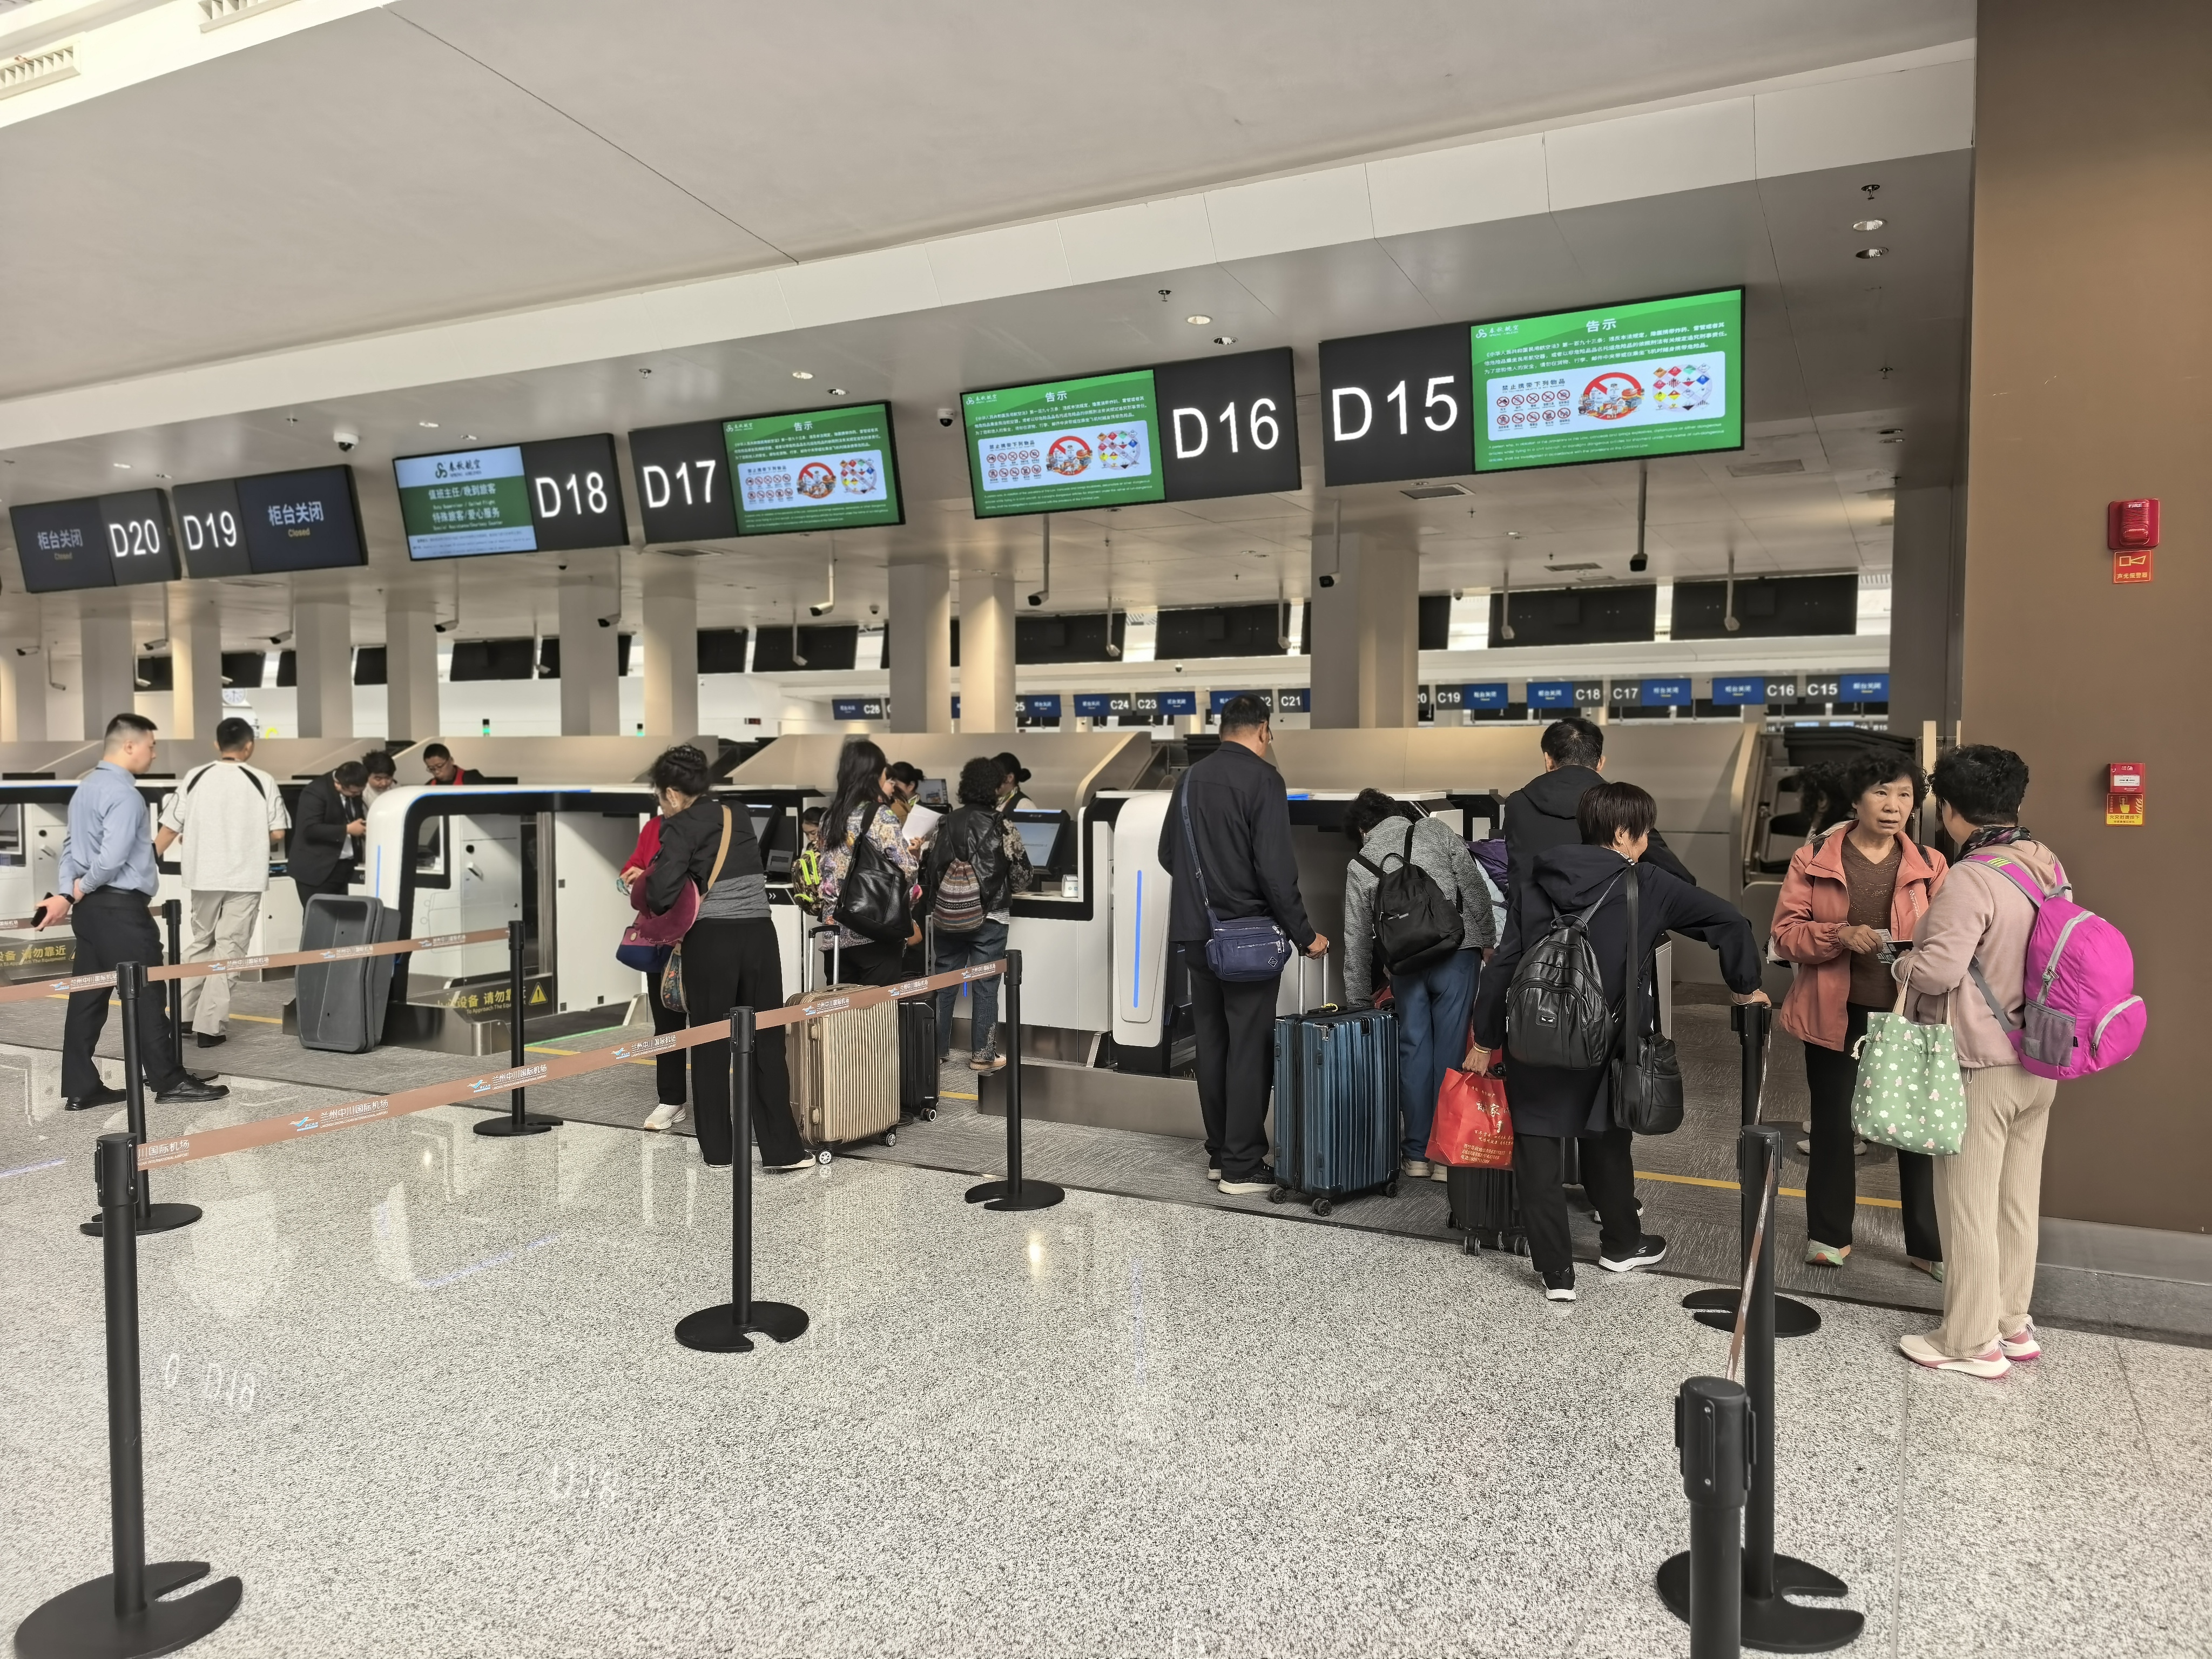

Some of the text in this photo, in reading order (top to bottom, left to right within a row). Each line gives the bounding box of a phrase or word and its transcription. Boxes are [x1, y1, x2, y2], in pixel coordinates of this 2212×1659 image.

[1586, 318, 1616, 333] 告示
[1045, 390, 1067, 402] 告示
[1332, 376, 1457, 441] D15
[794, 421, 813, 431] 告示
[1173, 399, 1278, 458] D16
[643, 460, 716, 508] D17
[536, 472, 607, 517] D18
[268, 501, 324, 526] 柜台关闭
[184, 511, 236, 550] D19
[288, 528, 310, 538] Closed
[37, 529, 83, 550] 柜台关闭
[109, 520, 159, 557] D20
[1576, 689, 1600, 700] C18
[1613, 688, 1638, 700] C17
[1767, 684, 1795, 696] C16
[1807, 684, 1837, 696] C15
[1281, 696, 1300, 706] C21
[1438, 692, 1460, 703] C19
[1015, 703, 1025, 712] 25
[1110, 700, 1129, 710] C24
[1137, 699, 1157, 709] C23
[473, 1004, 494, 1014] Approach
[817, 997, 849, 1009] 兰州中川国际机场
[631, 1035, 676, 1051] 兰州中川国际机场
[492, 1064, 547, 1083] 兰州中川国际机场
[321, 1099, 388, 1120] 兰州中川国际机场
